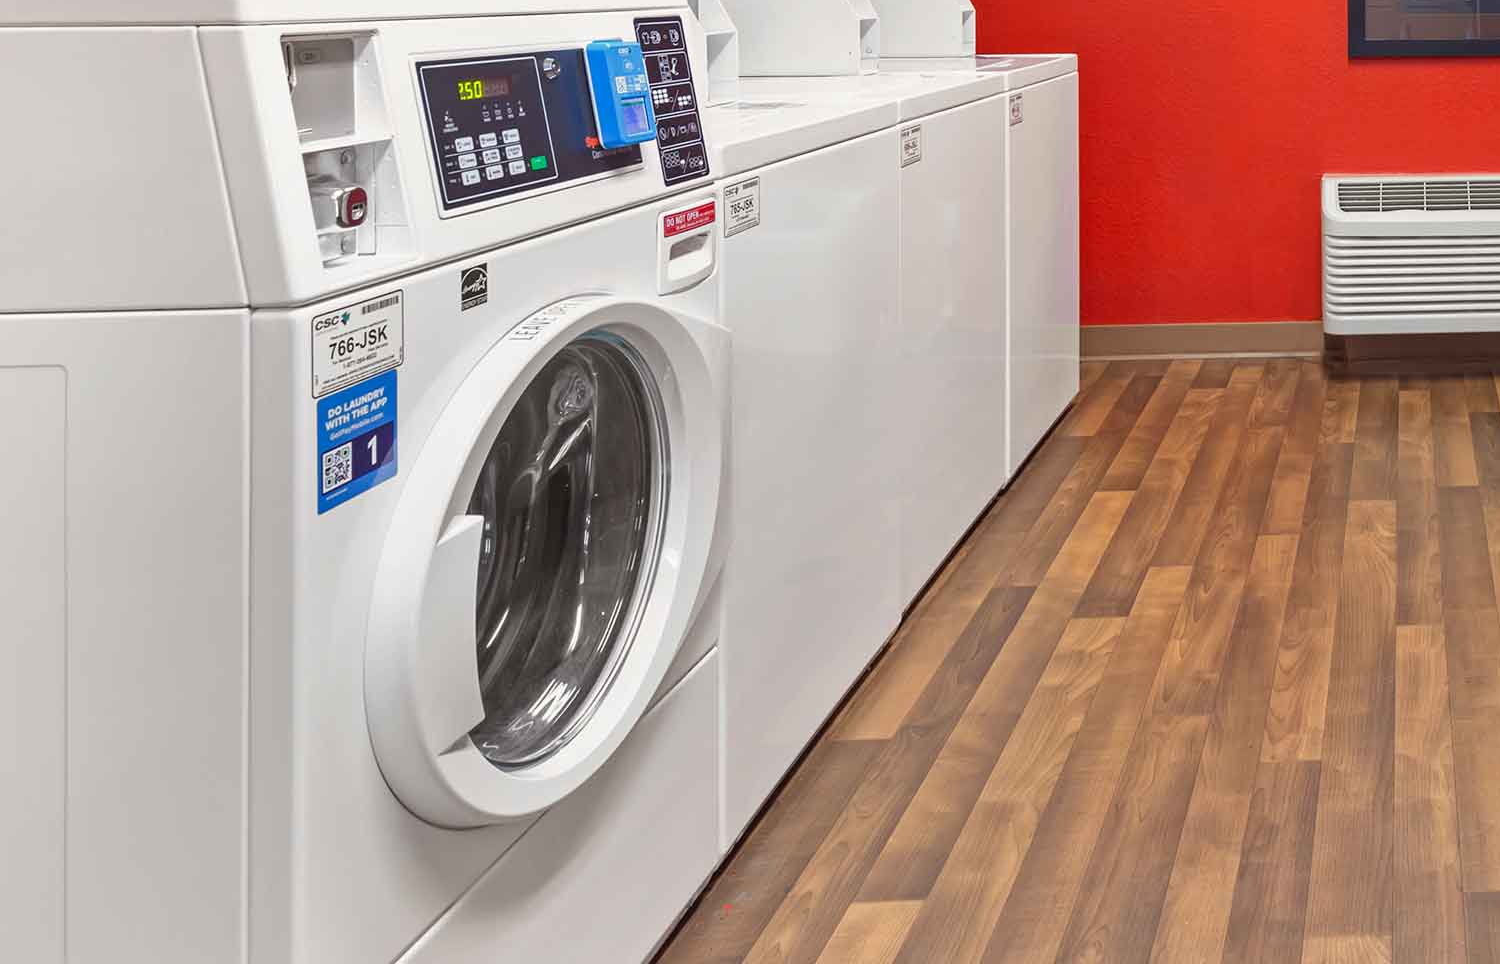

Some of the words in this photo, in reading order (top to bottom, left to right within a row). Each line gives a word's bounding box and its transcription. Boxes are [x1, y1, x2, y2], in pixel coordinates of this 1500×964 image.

[666, 218, 674, 227] DO
[676, 215, 685, 226] NOT
[315, 315, 339, 331] CSC
[329, 325, 388, 359] 766-JSK
[325, 413, 350, 431] WITH
[352, 405, 369, 419] THE
[370, 397, 388, 410] APP
[328, 405, 342, 419] DO
[344, 387, 385, 411] LAUNDRY
[367, 435, 377, 465] 1
